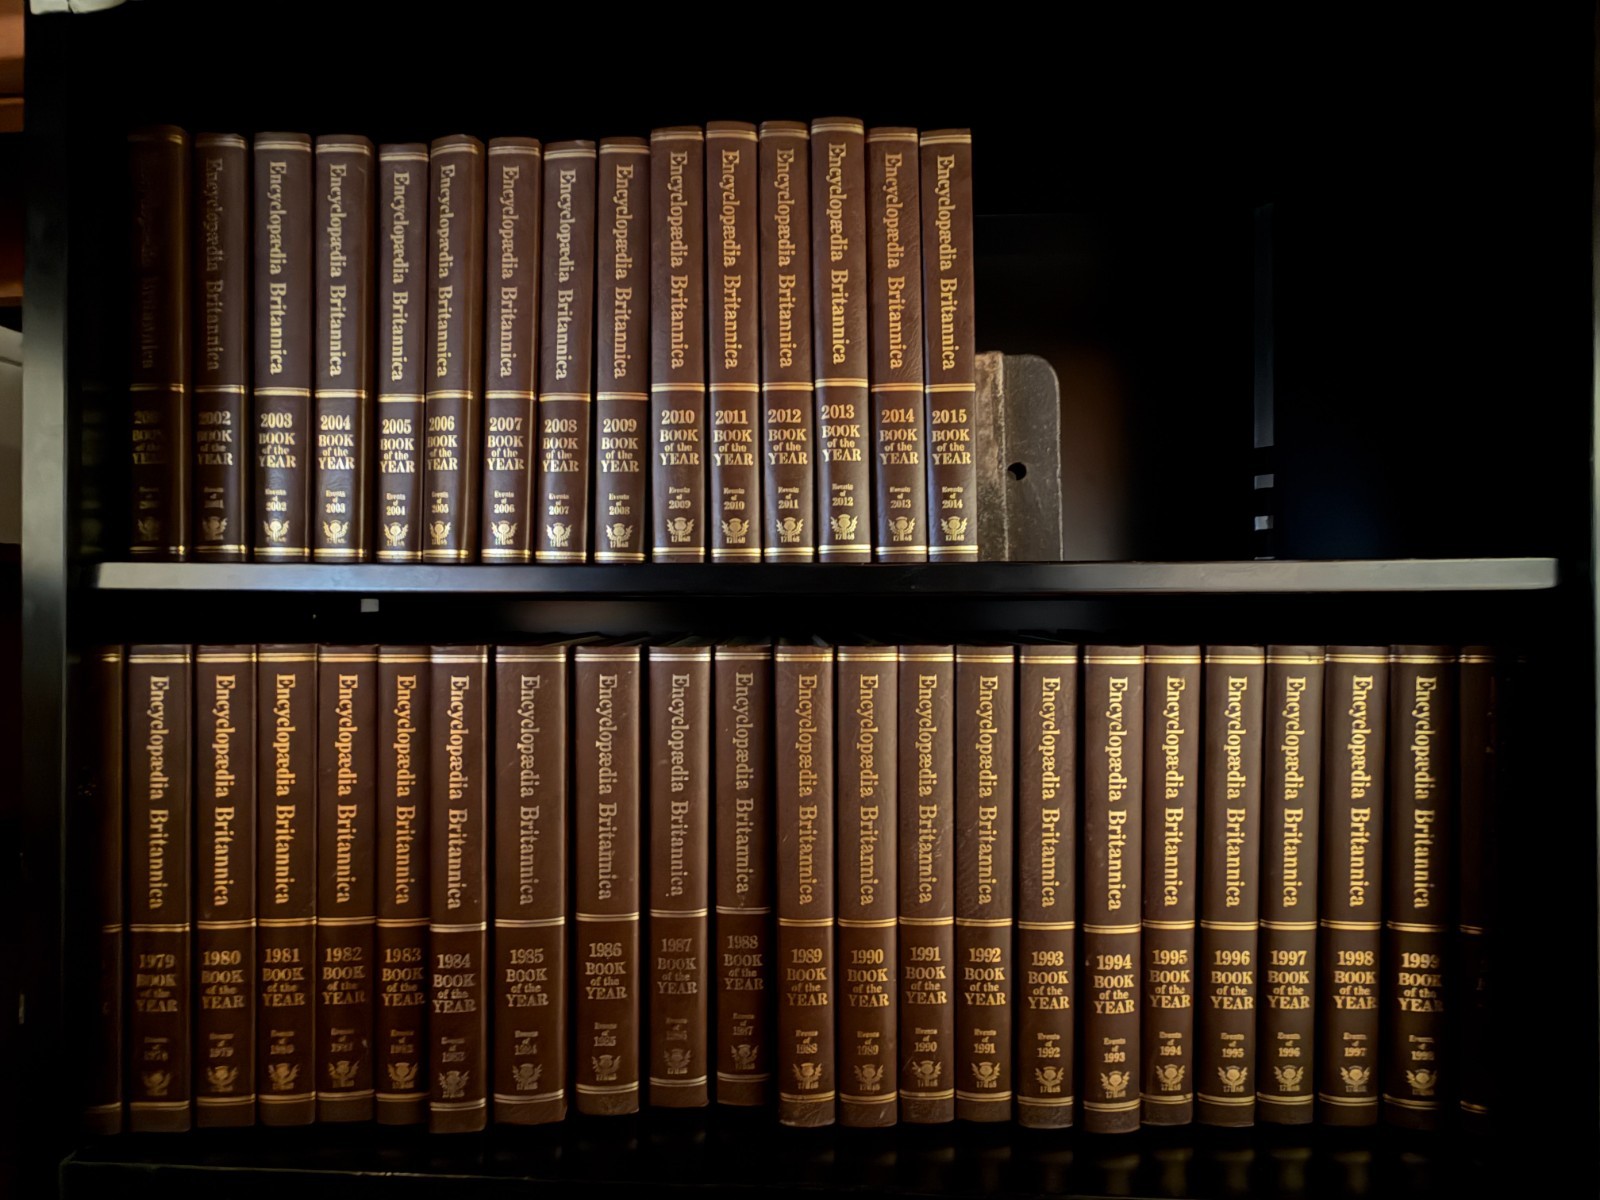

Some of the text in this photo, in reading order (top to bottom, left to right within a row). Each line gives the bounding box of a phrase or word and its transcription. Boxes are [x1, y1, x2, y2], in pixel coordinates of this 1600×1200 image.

[671, 275, 688, 369] Britannica
[724, 274, 742, 368] Britannica
[778, 274, 798, 368] Britannica
[831, 269, 850, 364] Britannica
[887, 276, 906, 370] Britannica
[940, 278, 958, 370] Britannica
[270, 282, 287, 375] Britannica
[330, 285, 347, 377] Britannica
[392, 291, 408, 381] Britannica
[437, 286, 453, 378] Britannica
[500, 287, 518, 378] Britannica
[556, 289, 574, 380] Britannica
[614, 287, 632, 379] Britannica
[261, 412, 293, 428] 2003
[661, 410, 694, 424] 2010
[715, 410, 748, 424] 2011
[768, 409, 801, 423] 2012
[821, 405, 854, 420] 2013
[882, 409, 914, 423] 2014
[932, 409, 967, 424] 2015
[320, 415, 352, 430] 2004
[382, 419, 411, 434] 2005
[429, 416, 455, 431] 2006
[490, 417, 523, 432] 2007
[544, 419, 577, 433] 2008
[603, 419, 637, 433] 2009
[659, 429, 698, 442] BOOK
[822, 425, 860, 438] BOOK
[932, 429, 970, 442] BOOK
[319, 435, 354, 447] BOOK
[487, 435, 523, 448] BOOK
[827, 439, 855, 448] of the
[937, 443, 965, 451] of the
[491, 449, 501, 457] of
[659, 453, 699, 465] YEAR
[822, 449, 861, 462] YEAR
[932, 452, 971, 465] YEAR
[319, 457, 355, 470] YEAR
[487, 458, 524, 470] YEAR
[432, 504, 449, 514] 2005
[494, 504, 515, 514] 2006
[669, 500, 691, 509] 2009
[724, 501, 744, 510] 2010
[778, 500, 799, 509] 2011
[832, 497, 853, 506] 2012
[891, 500, 911, 509] 2013
[942, 500, 963, 509] 2014
[549, 506, 569, 515] 2007
[609, 506, 630, 515] 2008
[336, 804, 357, 903] Britannica
[599, 802, 617, 900] Britannica
[671, 800, 689, 896] Britannica
[736, 798, 754, 894] Britannica
[149, 809, 169, 909] Britannica
[214, 806, 234, 906] Britannica
[275, 804, 295, 904] Britannica
[396, 806, 416, 905] Britannica
[448, 809, 467, 909] Britannica
[520, 806, 539, 905] Britannica
[799, 806, 818, 905] Britannica
[860, 806, 879, 906] Britannica
[919, 804, 937, 904] Britannica
[978, 806, 998, 905] Britannica
[1041, 808, 1060, 907] Britannica
[1108, 810, 1127, 911] Britannica
[1164, 807, 1184, 907] Britannica
[1226, 808, 1246, 908] Britannica
[1283, 808, 1304, 907] Britannica
[1349, 807, 1371, 908] Britannica
[1413, 809, 1436, 908] Britannica
[661, 938, 692, 952] 1987
[727, 935, 758, 949] 1988
[203, 950, 241, 966] 1980
[265, 948, 300, 962] 1981
[325, 947, 362, 962] 1982
[385, 948, 422, 963] 1983
[510, 949, 544, 964] 1985
[589, 943, 622, 958] 1986
[791, 948, 822, 964] 1989
[851, 949, 883, 964] 1990
[910, 946, 941, 962] 1991
[969, 947, 1001, 962] 1992
[1152, 950, 1188, 965] 1995
[1214, 950, 1250, 965] 1996
[1271, 950, 1307, 966] 1997
[1337, 950, 1374, 966] 1998
[437, 953, 471, 969] 1984
[1031, 951, 1064, 966] 1993
[1096, 954, 1132, 970] 1994
[1401, 953, 1440, 968] 1999
[506, 968, 548, 982] BOOK
[905, 966, 946, 980] BOOK
[1267, 971, 1310, 985] BOOK
[911, 981, 941, 991] of the
[1094, 975, 1134, 988] BOOK
[905, 992, 947, 1004] YEAR
[1273, 985, 1304, 996] of the
[506, 995, 549, 1007] YEAR
[1094, 1000, 1135, 1014] YEAR
[1267, 996, 1310, 1010] YEAR
[915, 1042, 937, 1052] 1990
[974, 1044, 995, 1054] 1991
[1104, 1053, 1125, 1062] 1993
